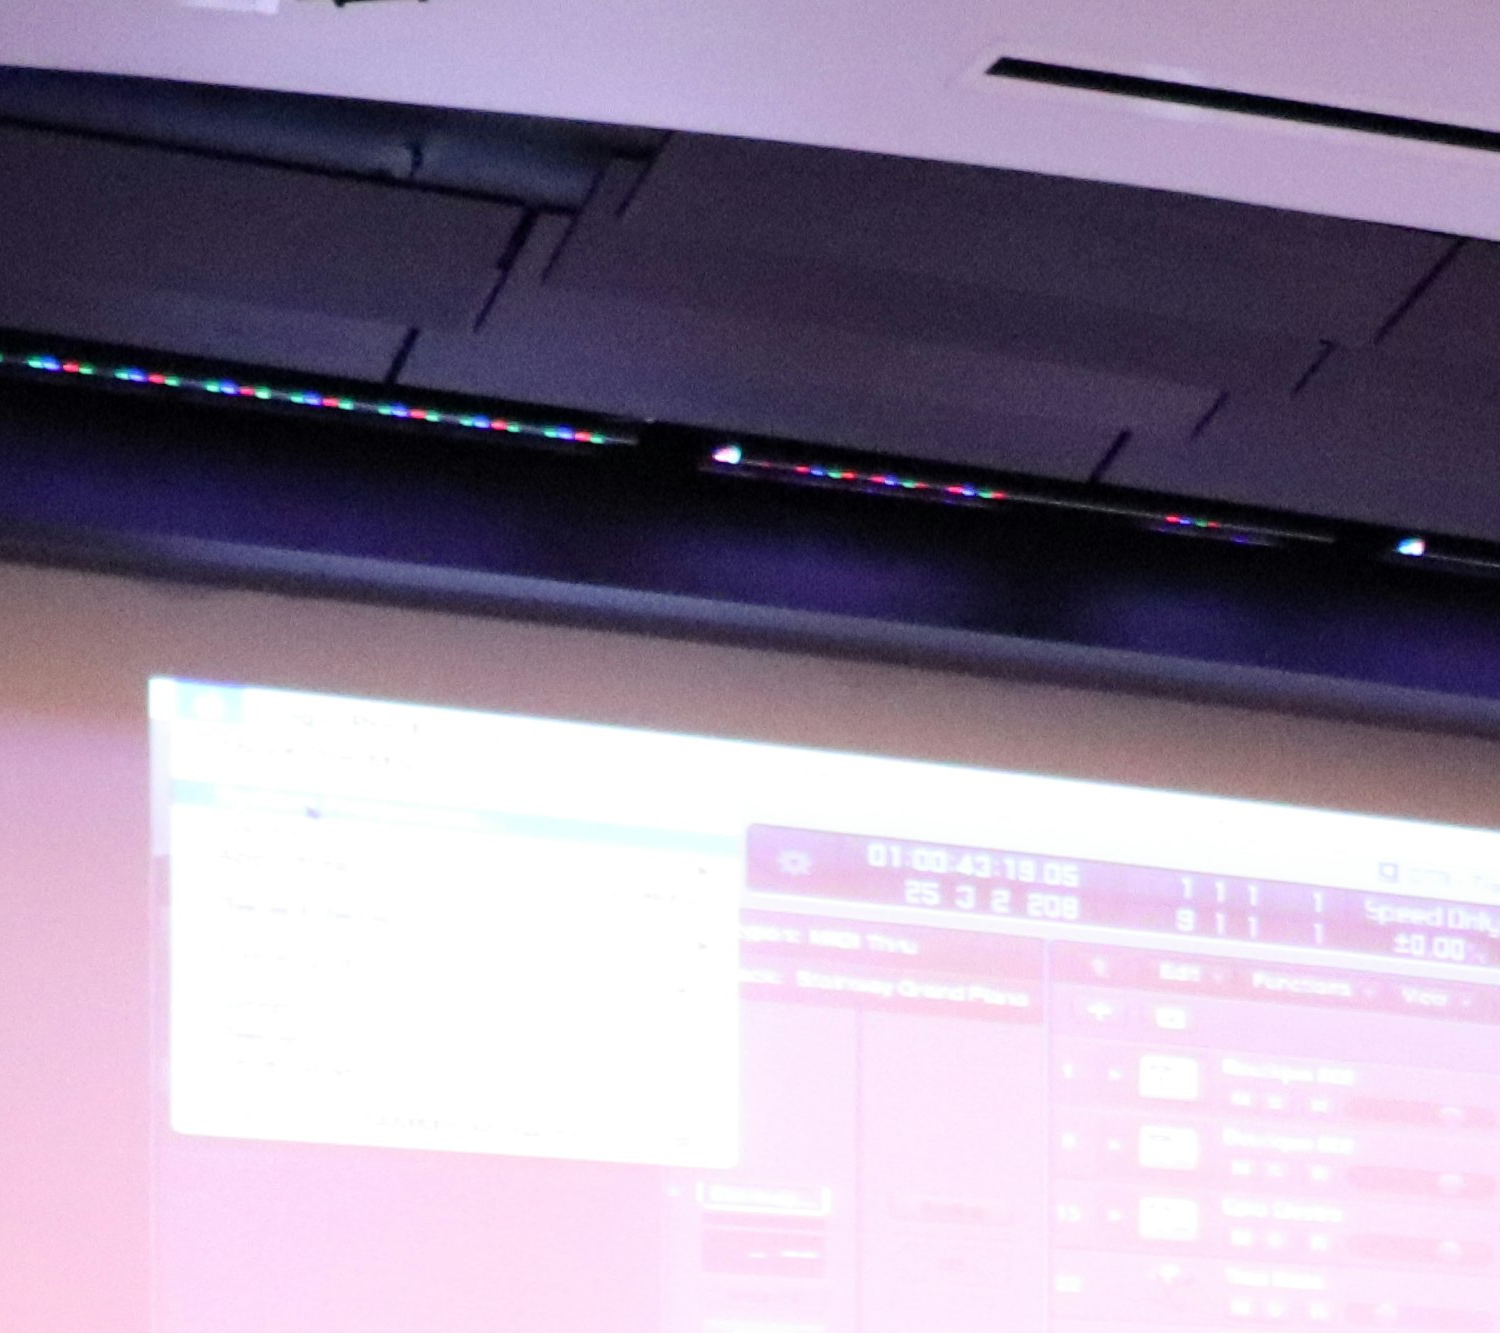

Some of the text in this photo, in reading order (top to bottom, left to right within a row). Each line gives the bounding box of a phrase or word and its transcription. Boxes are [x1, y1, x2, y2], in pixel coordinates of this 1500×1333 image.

[904, 879, 942, 906] 25
[954, 885, 976, 910] 3
[990, 888, 1011, 914] 2
[1176, 907, 1195, 932] 9
[1364, 898, 1443, 927] Speed
